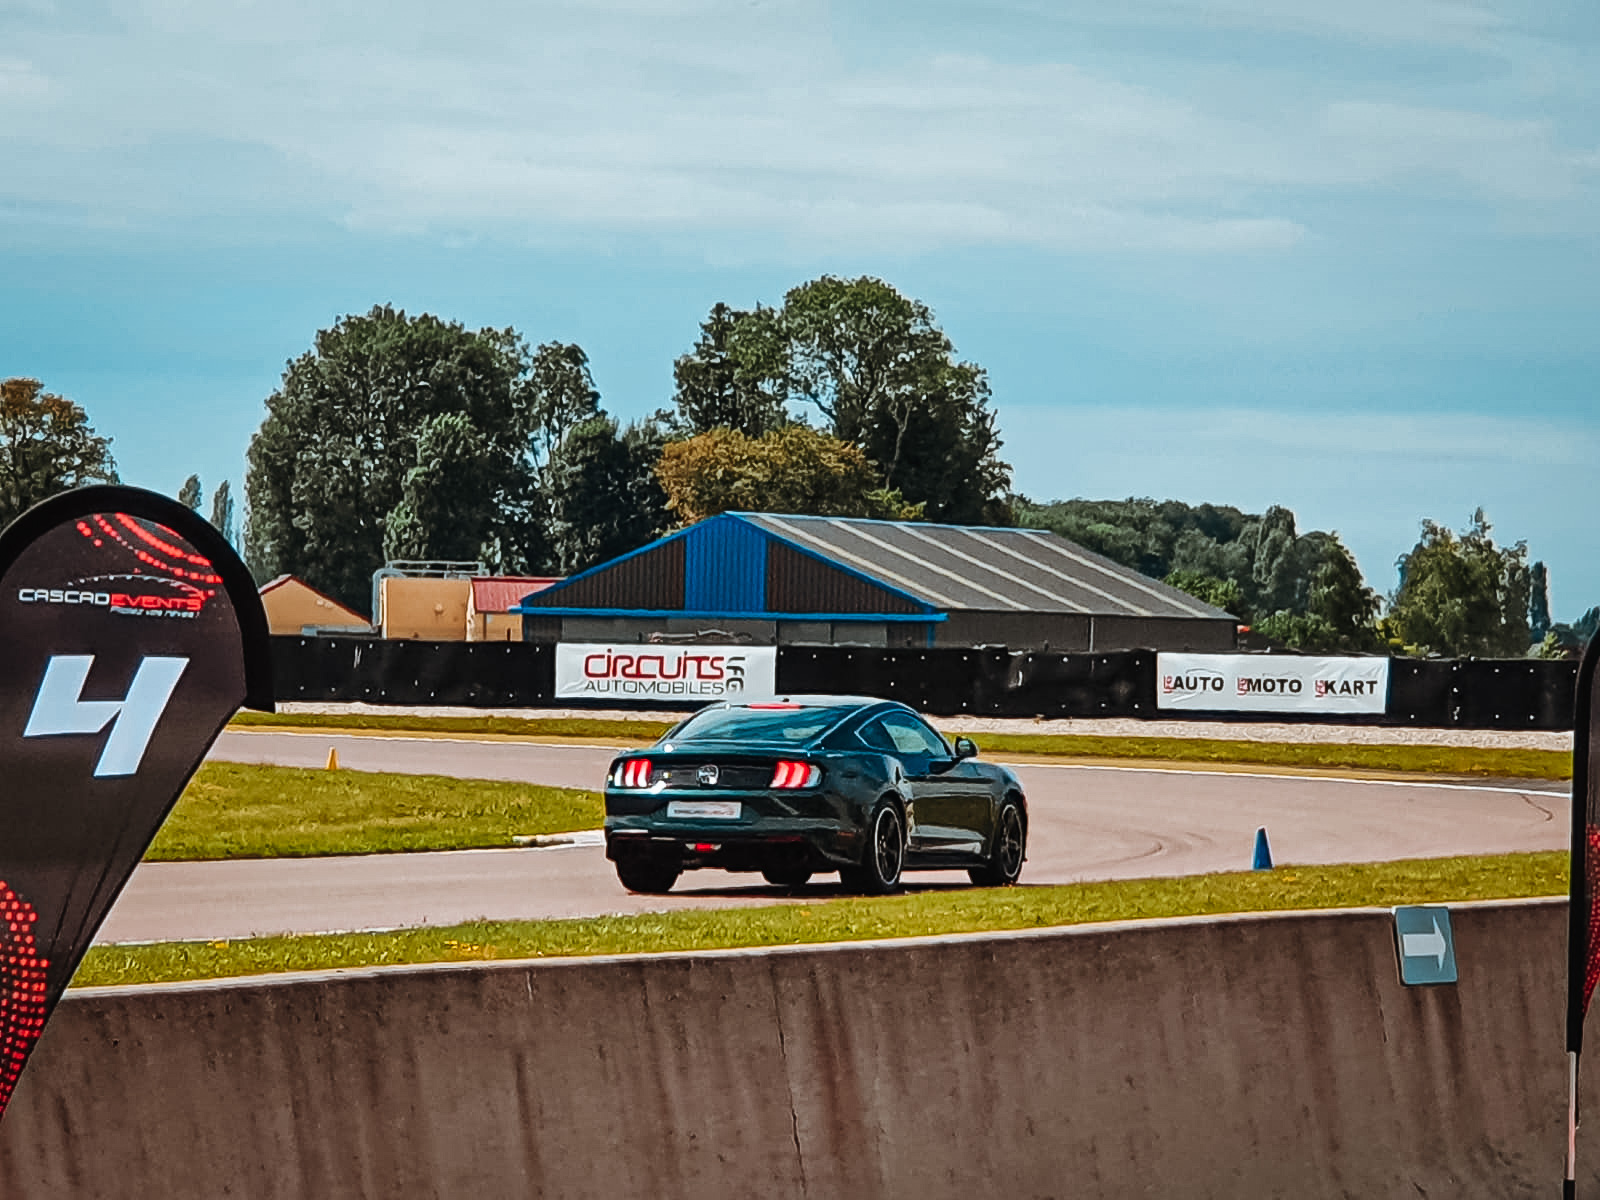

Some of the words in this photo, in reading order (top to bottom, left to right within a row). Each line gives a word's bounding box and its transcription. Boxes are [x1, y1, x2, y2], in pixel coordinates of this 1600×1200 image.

[584, 680, 724, 695] AUTOMOBILES
[1173, 676, 1224, 691] AUTO
[1247, 678, 1302, 693] MOTO
[1325, 680, 1378, 694] KART
[23, 655, 190, 777] 4
